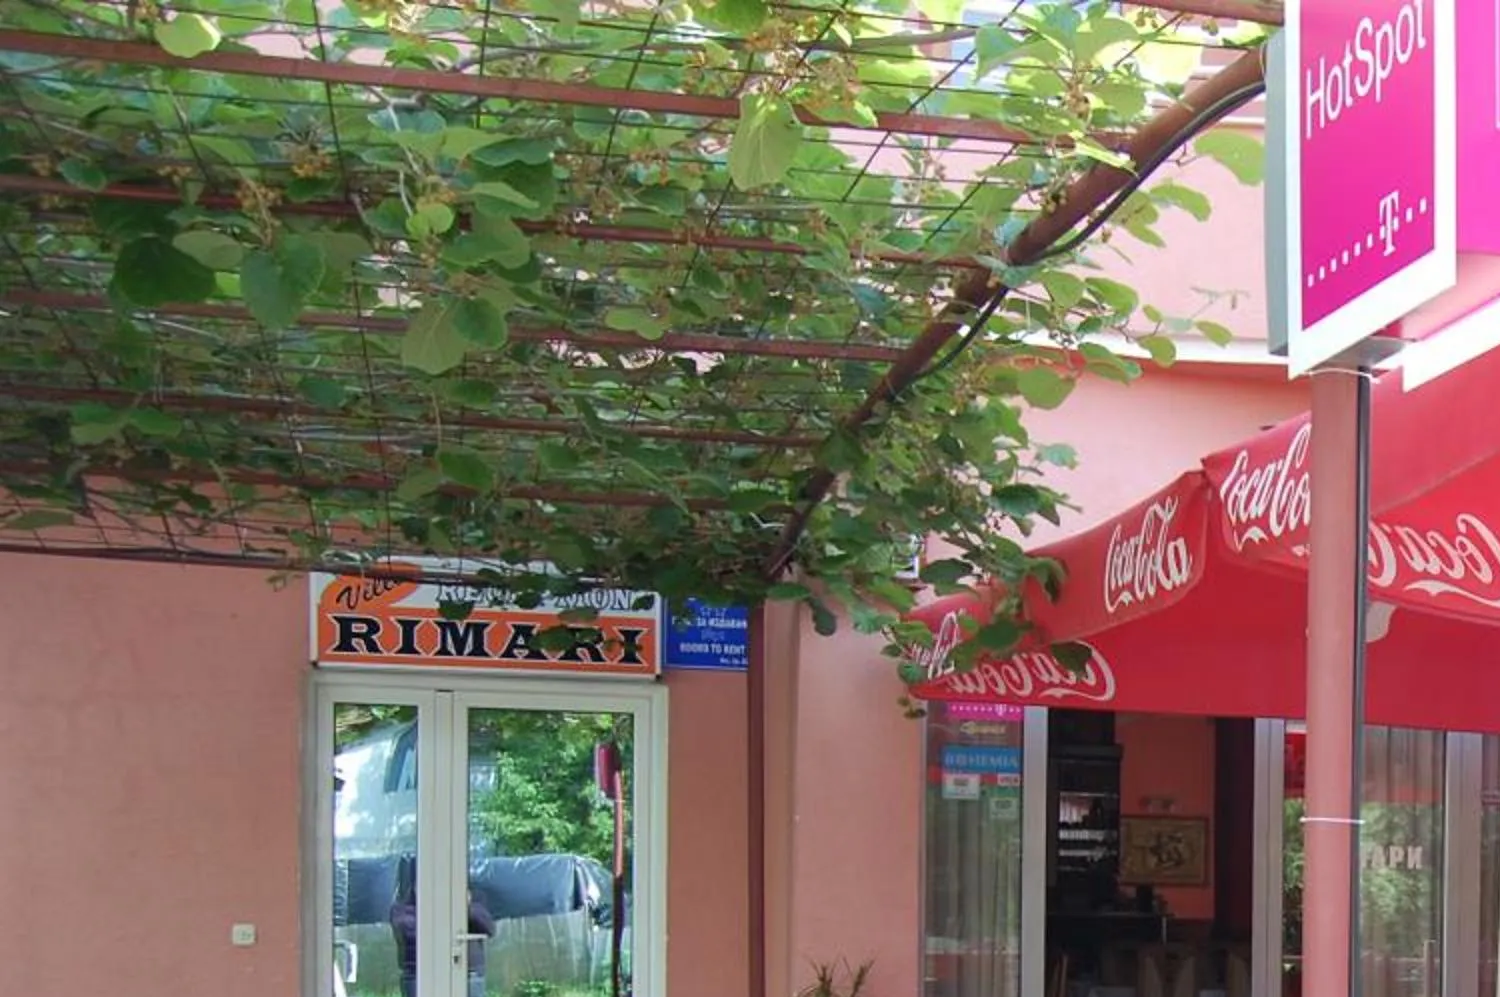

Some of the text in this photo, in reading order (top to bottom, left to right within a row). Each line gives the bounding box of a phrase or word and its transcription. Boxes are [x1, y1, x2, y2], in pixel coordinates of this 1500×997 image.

[1305, 0, 1427, 139] HotSpot
[1105, 495, 1193, 613] Coca-Cola
[329, 614, 647, 666] RIMARI
